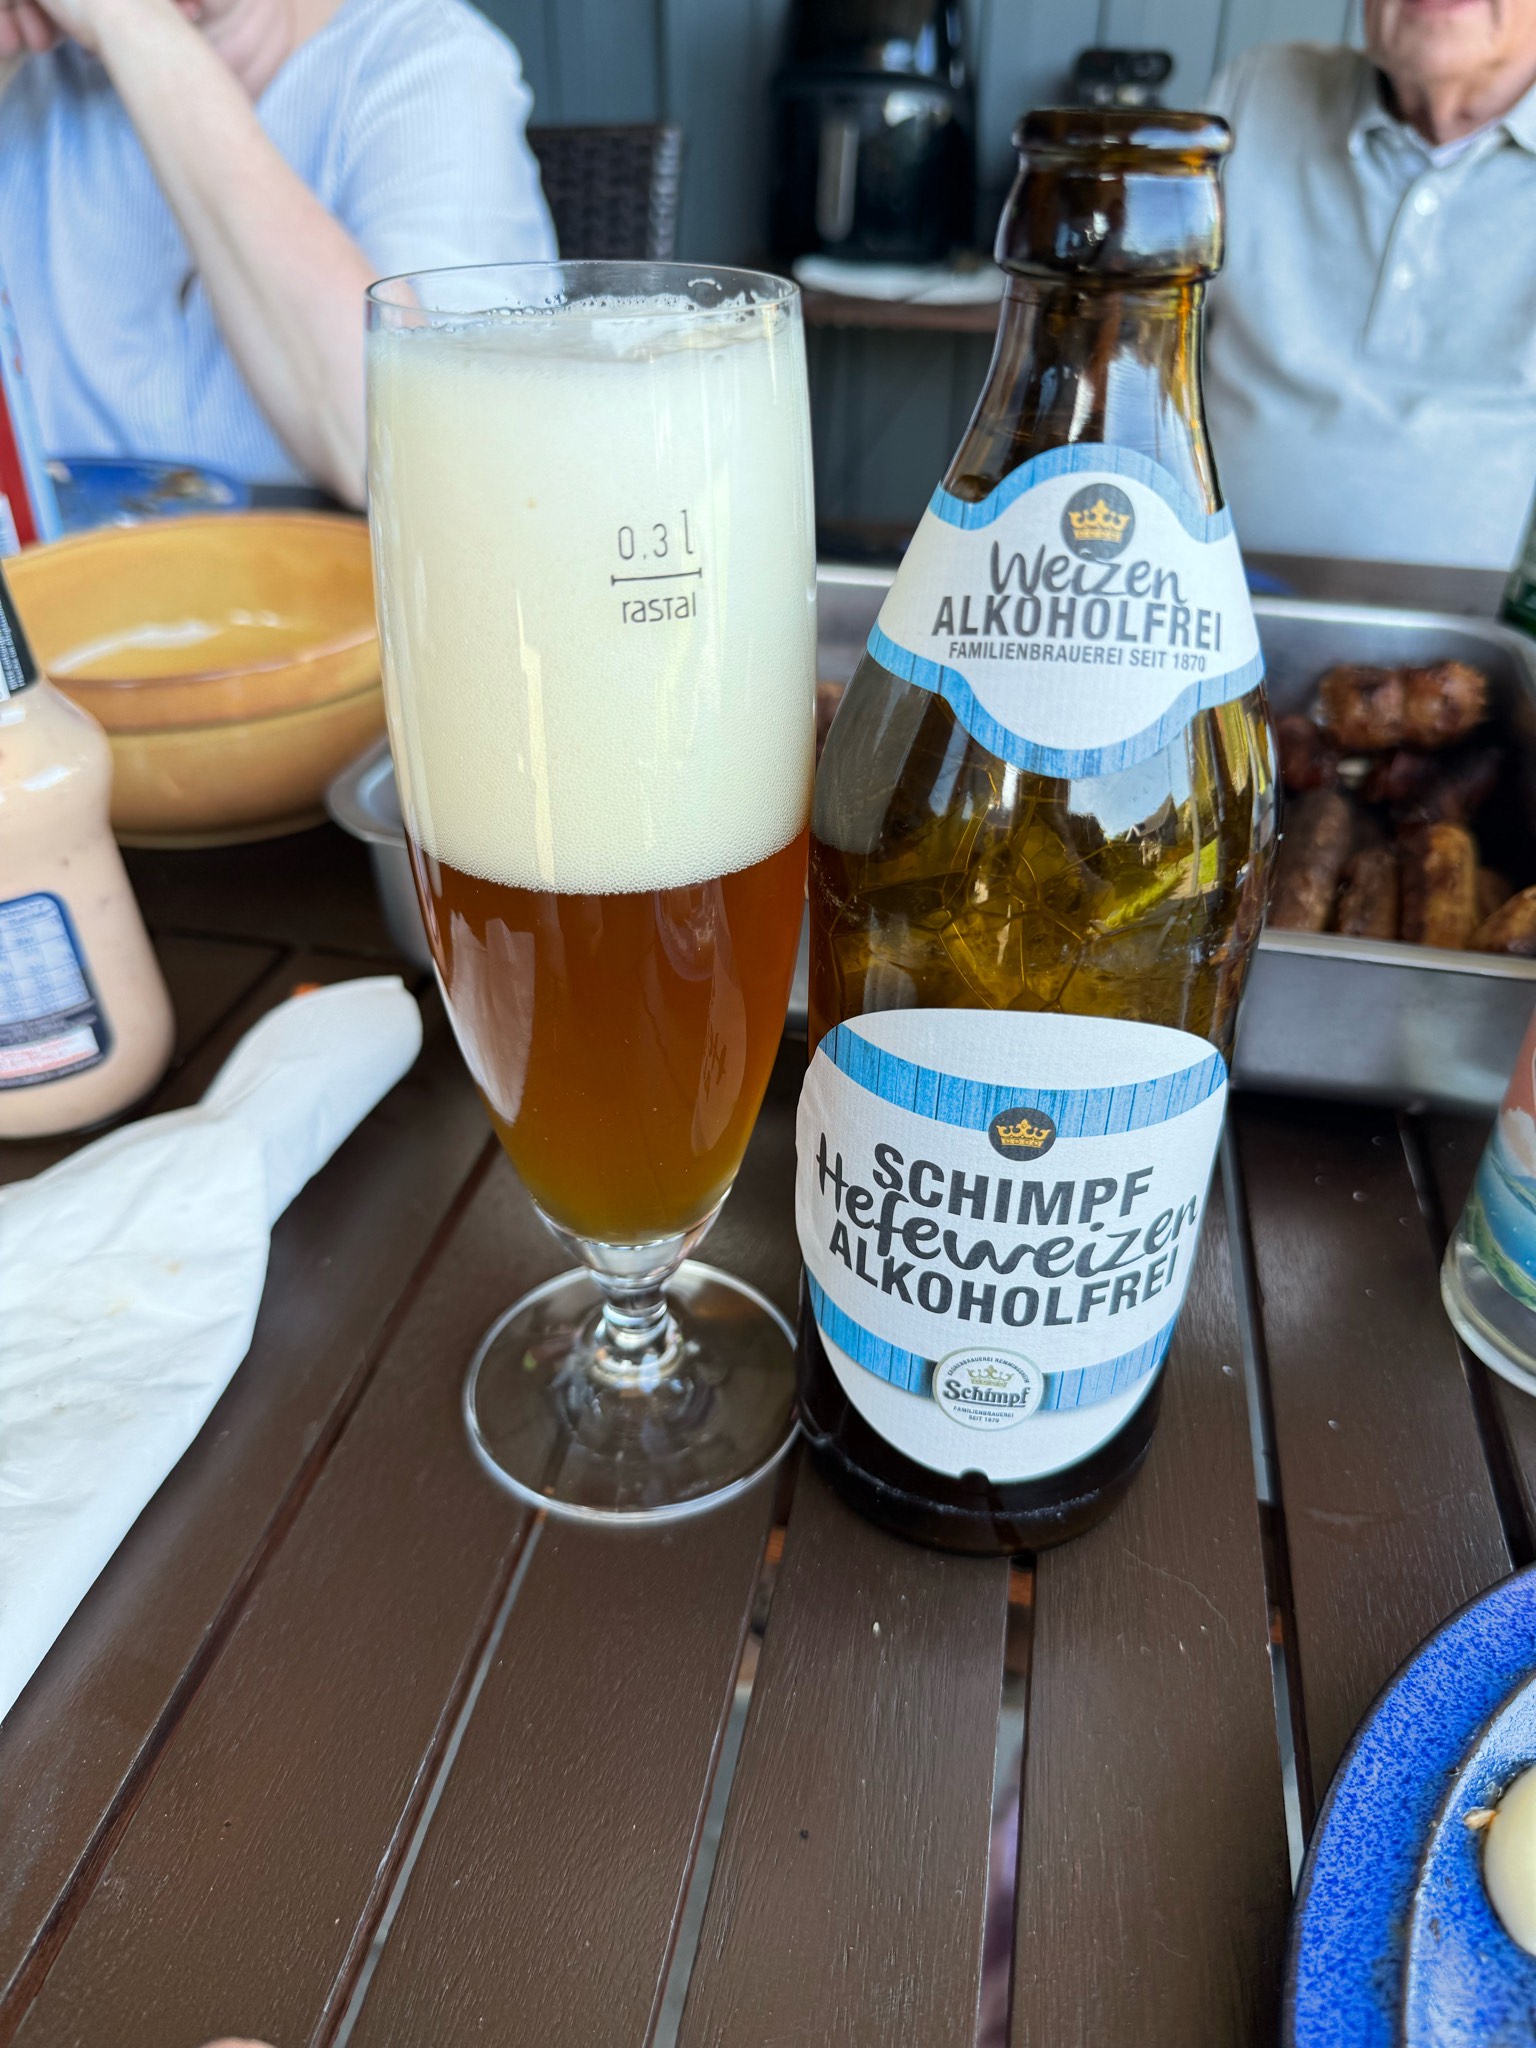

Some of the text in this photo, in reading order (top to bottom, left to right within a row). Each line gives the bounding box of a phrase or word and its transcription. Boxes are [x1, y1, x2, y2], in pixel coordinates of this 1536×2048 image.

[990, 540, 1187, 604] Weizen
[622, 591, 697, 624] rastal
[931, 594, 1221, 651] ALKOHOLFREI
[948, 641, 1206, 673] FAMILIENBRAUEREI SEIT 1870
[816, 1132, 1198, 1278] Hefeweizen
[872, 1142, 1154, 1226] SCHIMPF
[829, 1218, 1180, 1327] ALKOHOLFREI
[942, 1379, 1031, 1407] Schimpf
